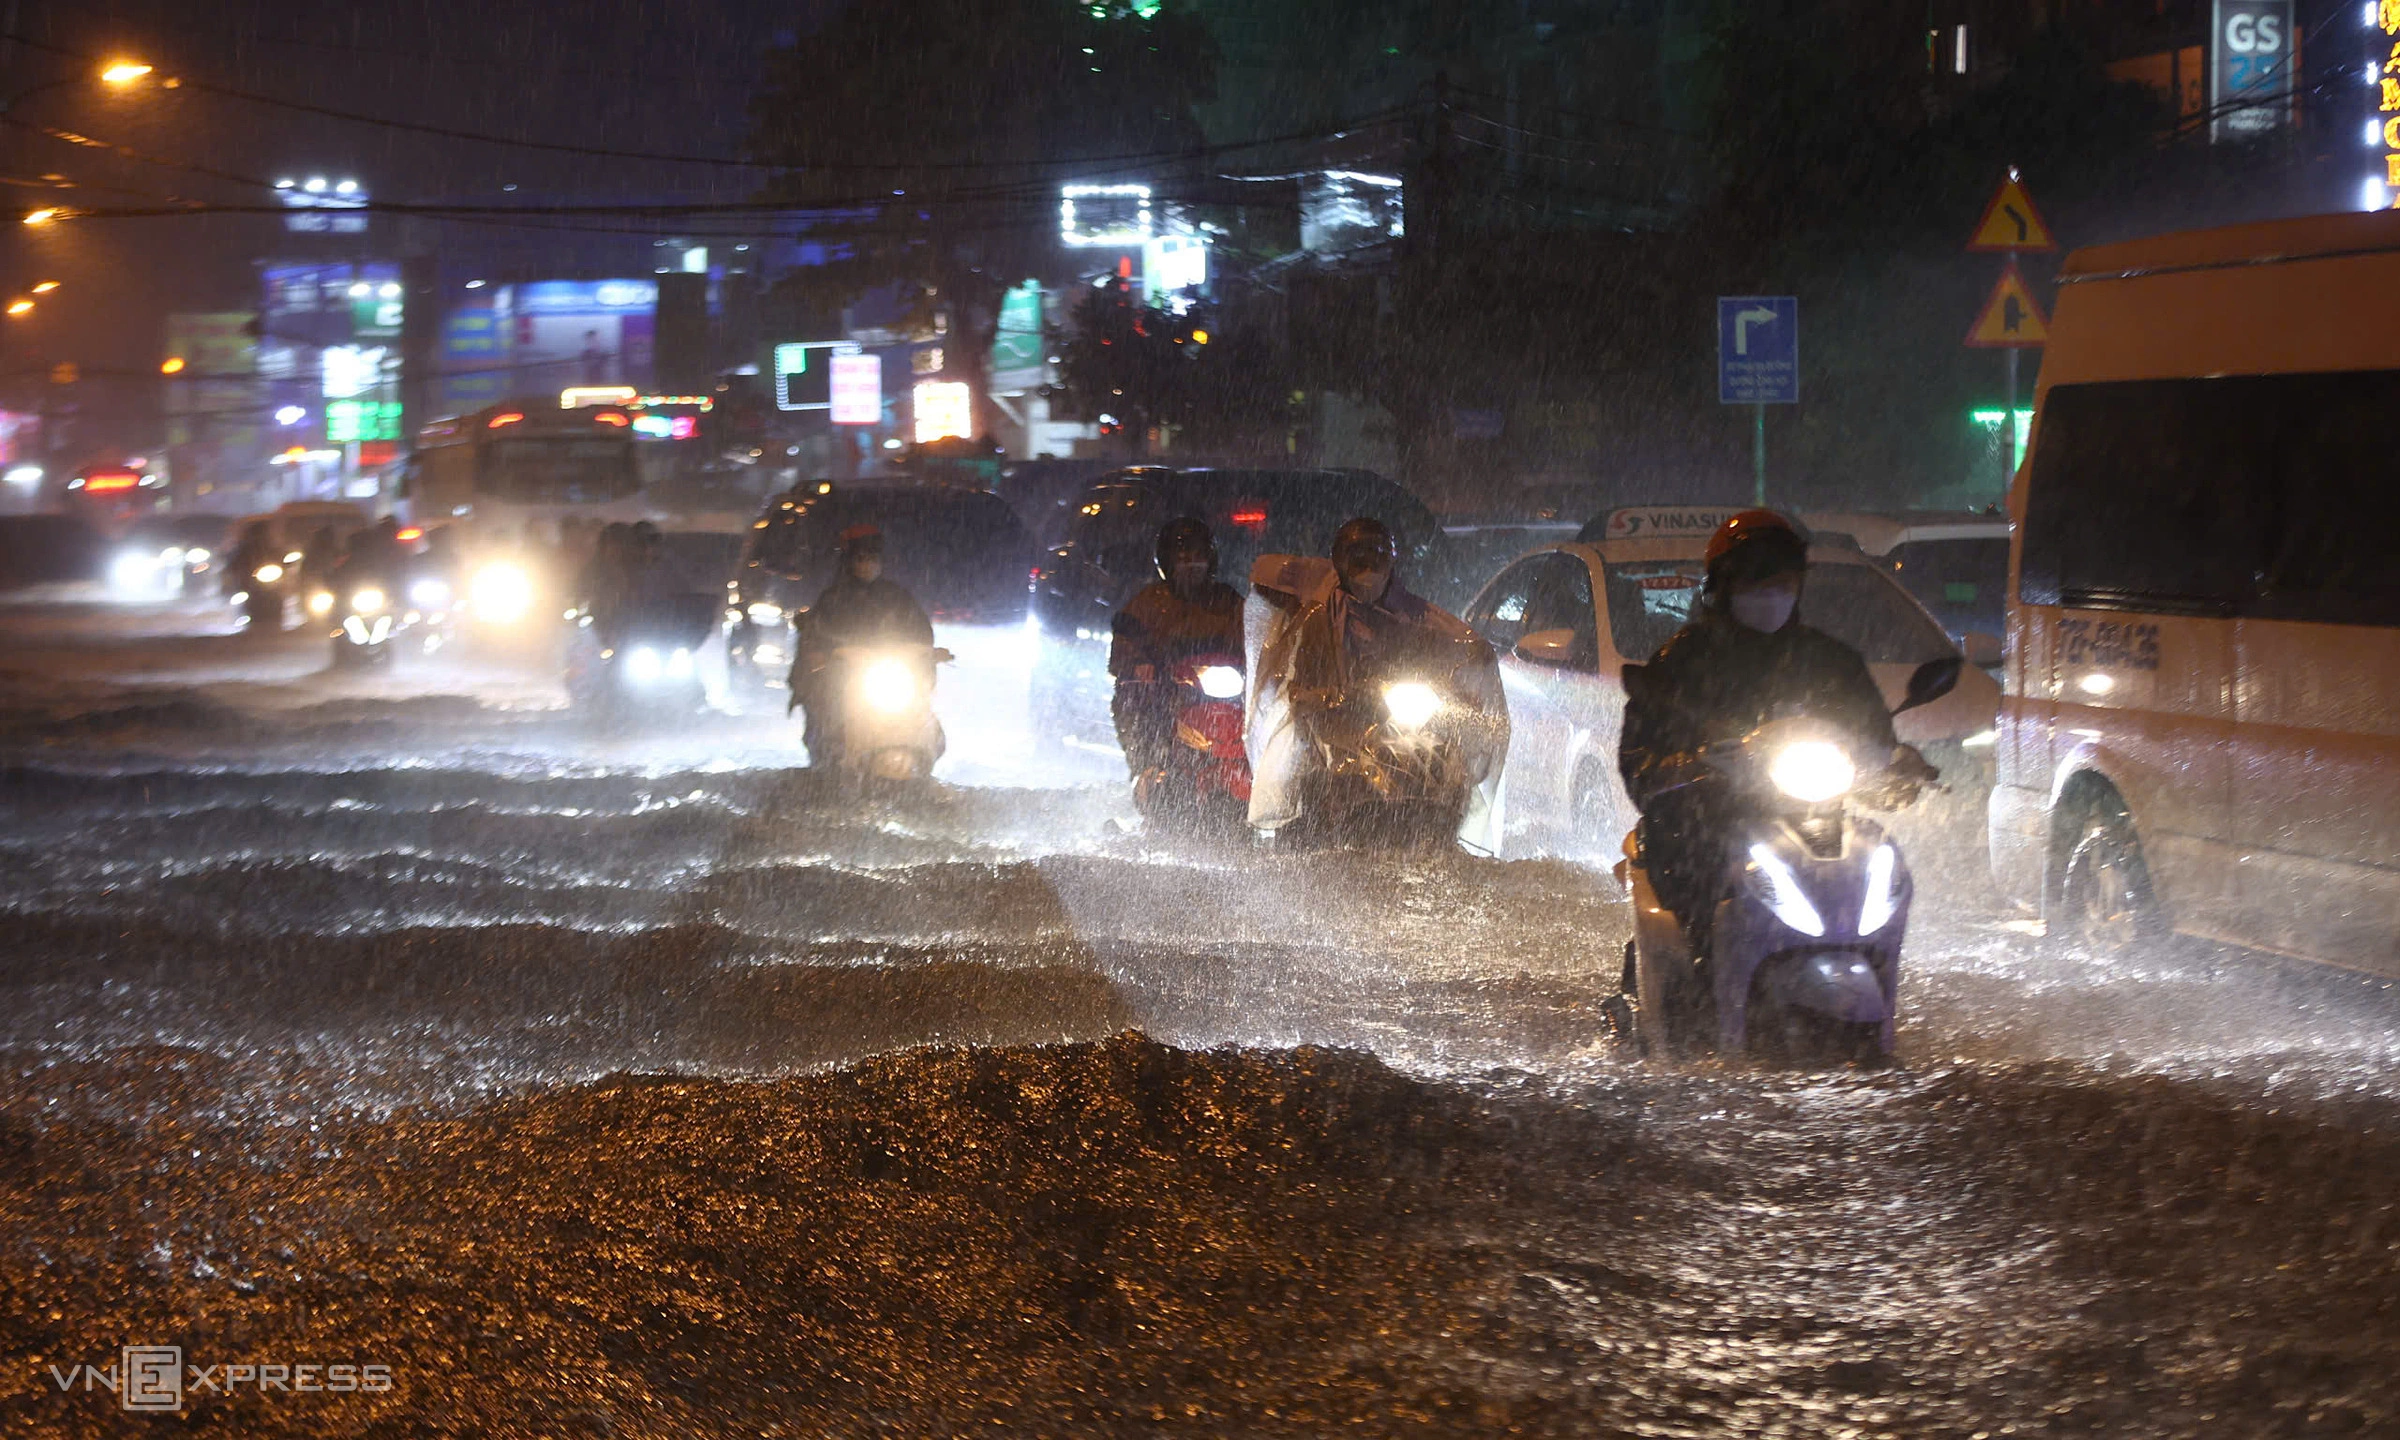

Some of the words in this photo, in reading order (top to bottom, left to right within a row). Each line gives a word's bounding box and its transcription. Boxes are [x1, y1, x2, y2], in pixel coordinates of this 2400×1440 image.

[2225, 13, 2281, 53] GS
[2228, 55, 2279, 92] 25
[1649, 513, 1731, 529] VINASU
